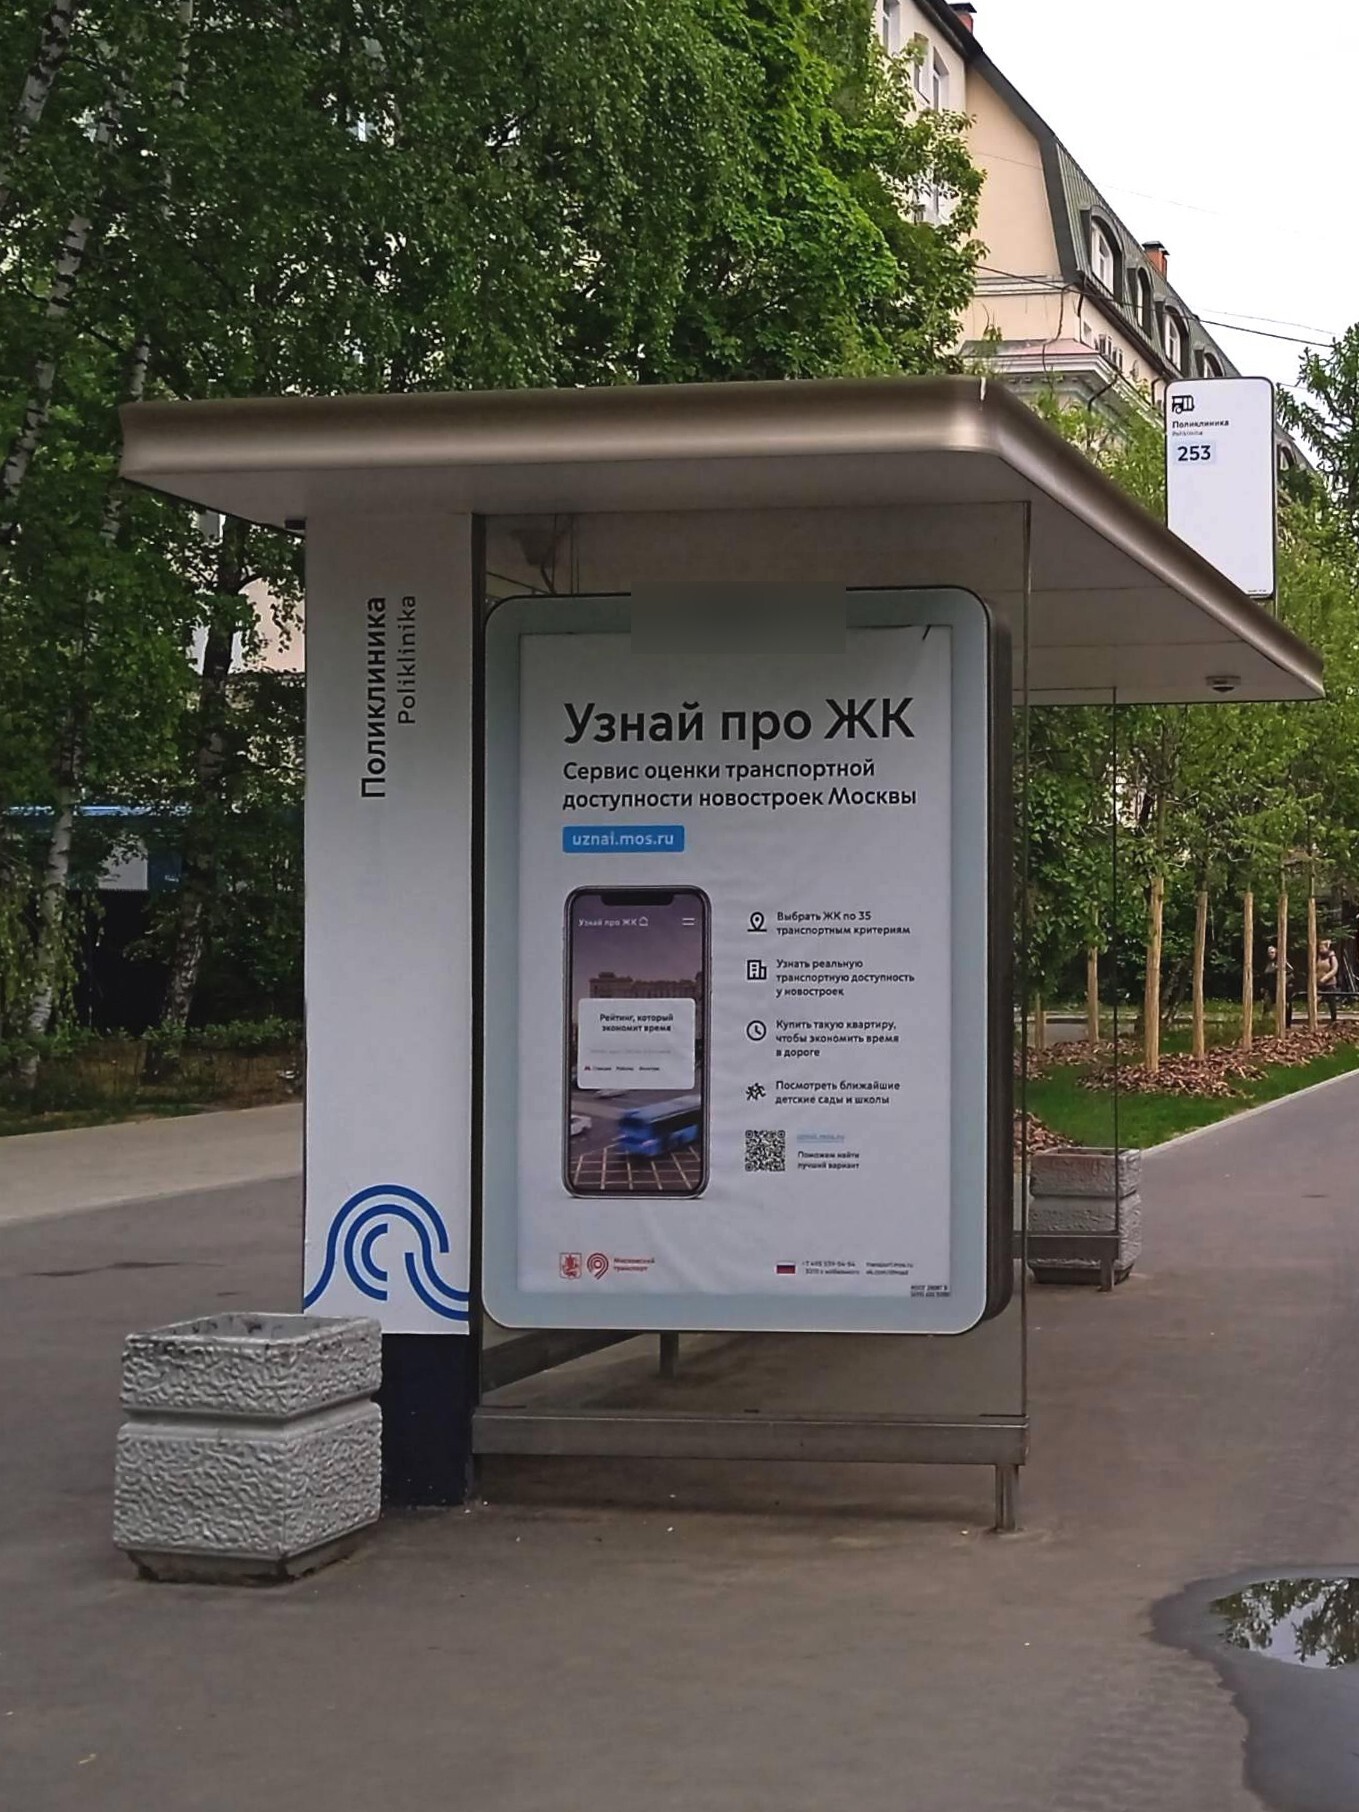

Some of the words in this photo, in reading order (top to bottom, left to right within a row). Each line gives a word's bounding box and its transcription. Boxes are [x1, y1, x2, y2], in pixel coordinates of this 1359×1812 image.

[1172, 420, 1229, 429] Поликлиника
[1177, 445, 1211, 461] 253
[396, 595, 416, 724] Poliklinika
[361, 597, 386, 798] Поликлиника
[563, 701, 705, 744] Узнай
[721, 709, 812, 750] про
[824, 698, 915, 740] ЖК
[563, 762, 639, 782] Сервис
[645, 762, 720, 782] оценки
[726, 758, 875, 780] транспортной
[562, 791, 693, 811] доступности
[699, 789, 824, 809] новостроек
[828, 787, 917, 806] Москвы
[572, 832, 674, 846] uznai.mos.ru
[777, 911, 821, 923] Выбрать
[823, 911, 841, 921] ЖК
[843, 912, 856, 921] по
[858, 911, 872, 921] 35
[776, 926, 851, 936] транспортным
[854, 926, 911, 936] критериям
[776, 959, 810, 969] Узнать
[812, 960, 863, 970] реальную
[776, 974, 850, 984] транспортную
[851, 973, 915, 984] доступность
[776, 988, 782, 998] у
[785, 988, 844, 997] новостроек
[600, 1013, 635, 1023] Рейтинг,
[637, 1013, 674, 1022] который
[644, 1025, 671, 1033] время
[776, 1020, 812, 1030] Купить
[814, 1021, 844, 1030] такую
[846, 1020, 896, 1030] квартиру,
[776, 1034, 807, 1043] чтобы
[810, 1035, 863, 1043] экономить
[867, 1034, 899, 1043] время
[784, 1049, 820, 1058] дороге
[775, 1080, 837, 1091] Посмотреть
[839, 1080, 901, 1091] ближайшие
[775, 1096, 816, 1105] детские
[818, 1096, 843, 1105] сады
[846, 1096, 852, 1104] и
[855, 1096, 890, 1105] школы
